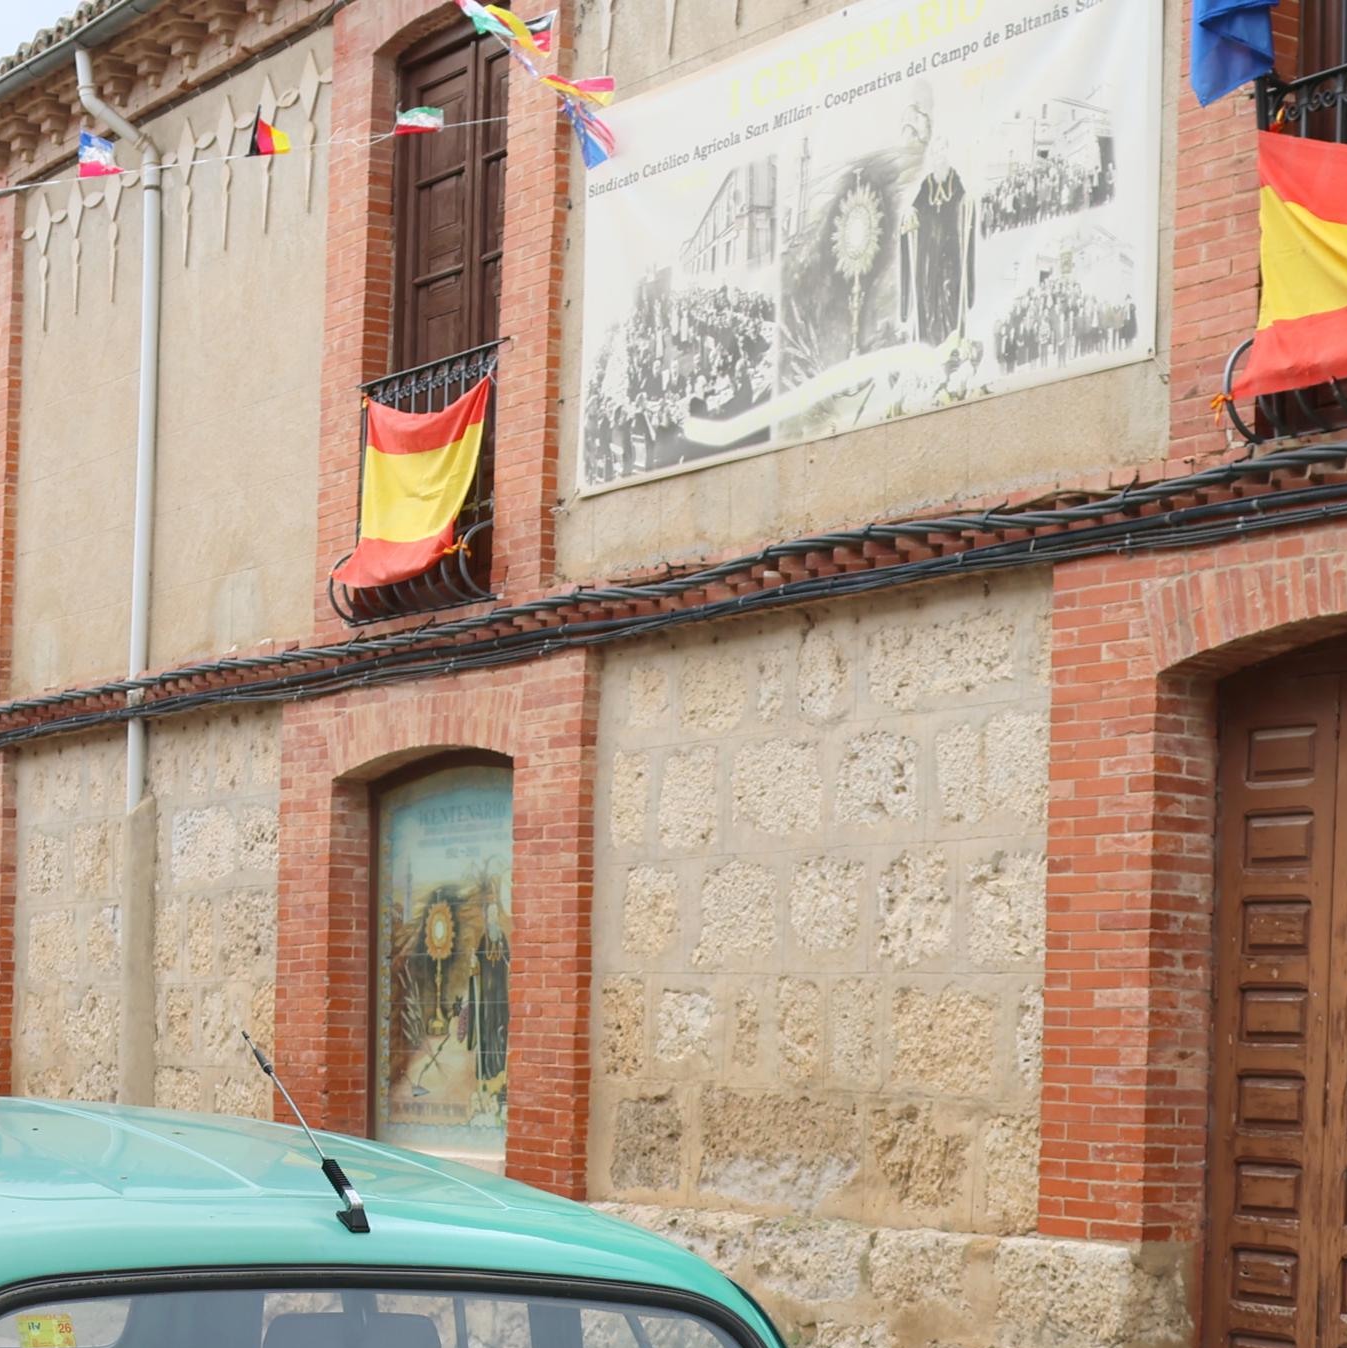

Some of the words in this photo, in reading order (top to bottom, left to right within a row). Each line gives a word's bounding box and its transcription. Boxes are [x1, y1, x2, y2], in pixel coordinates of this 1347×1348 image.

[588, 168, 640, 198] Sindicato
[642, 151, 690, 178] Católico
[693, 132, 742, 161] Agrícola
[745, 121, 770, 140] San
[773, 103, 813, 131] Millán
[824, 67, 903, 110] Cooperativa
[906, 57, 927, 77] del
[931, 40, 979, 70] Campo
[983, 31, 1001, 48] de
[1004, 4, 1070, 41] Baltanás
[728, 79, 742, 119] I
[58, 1322, 72, 1334] 26
